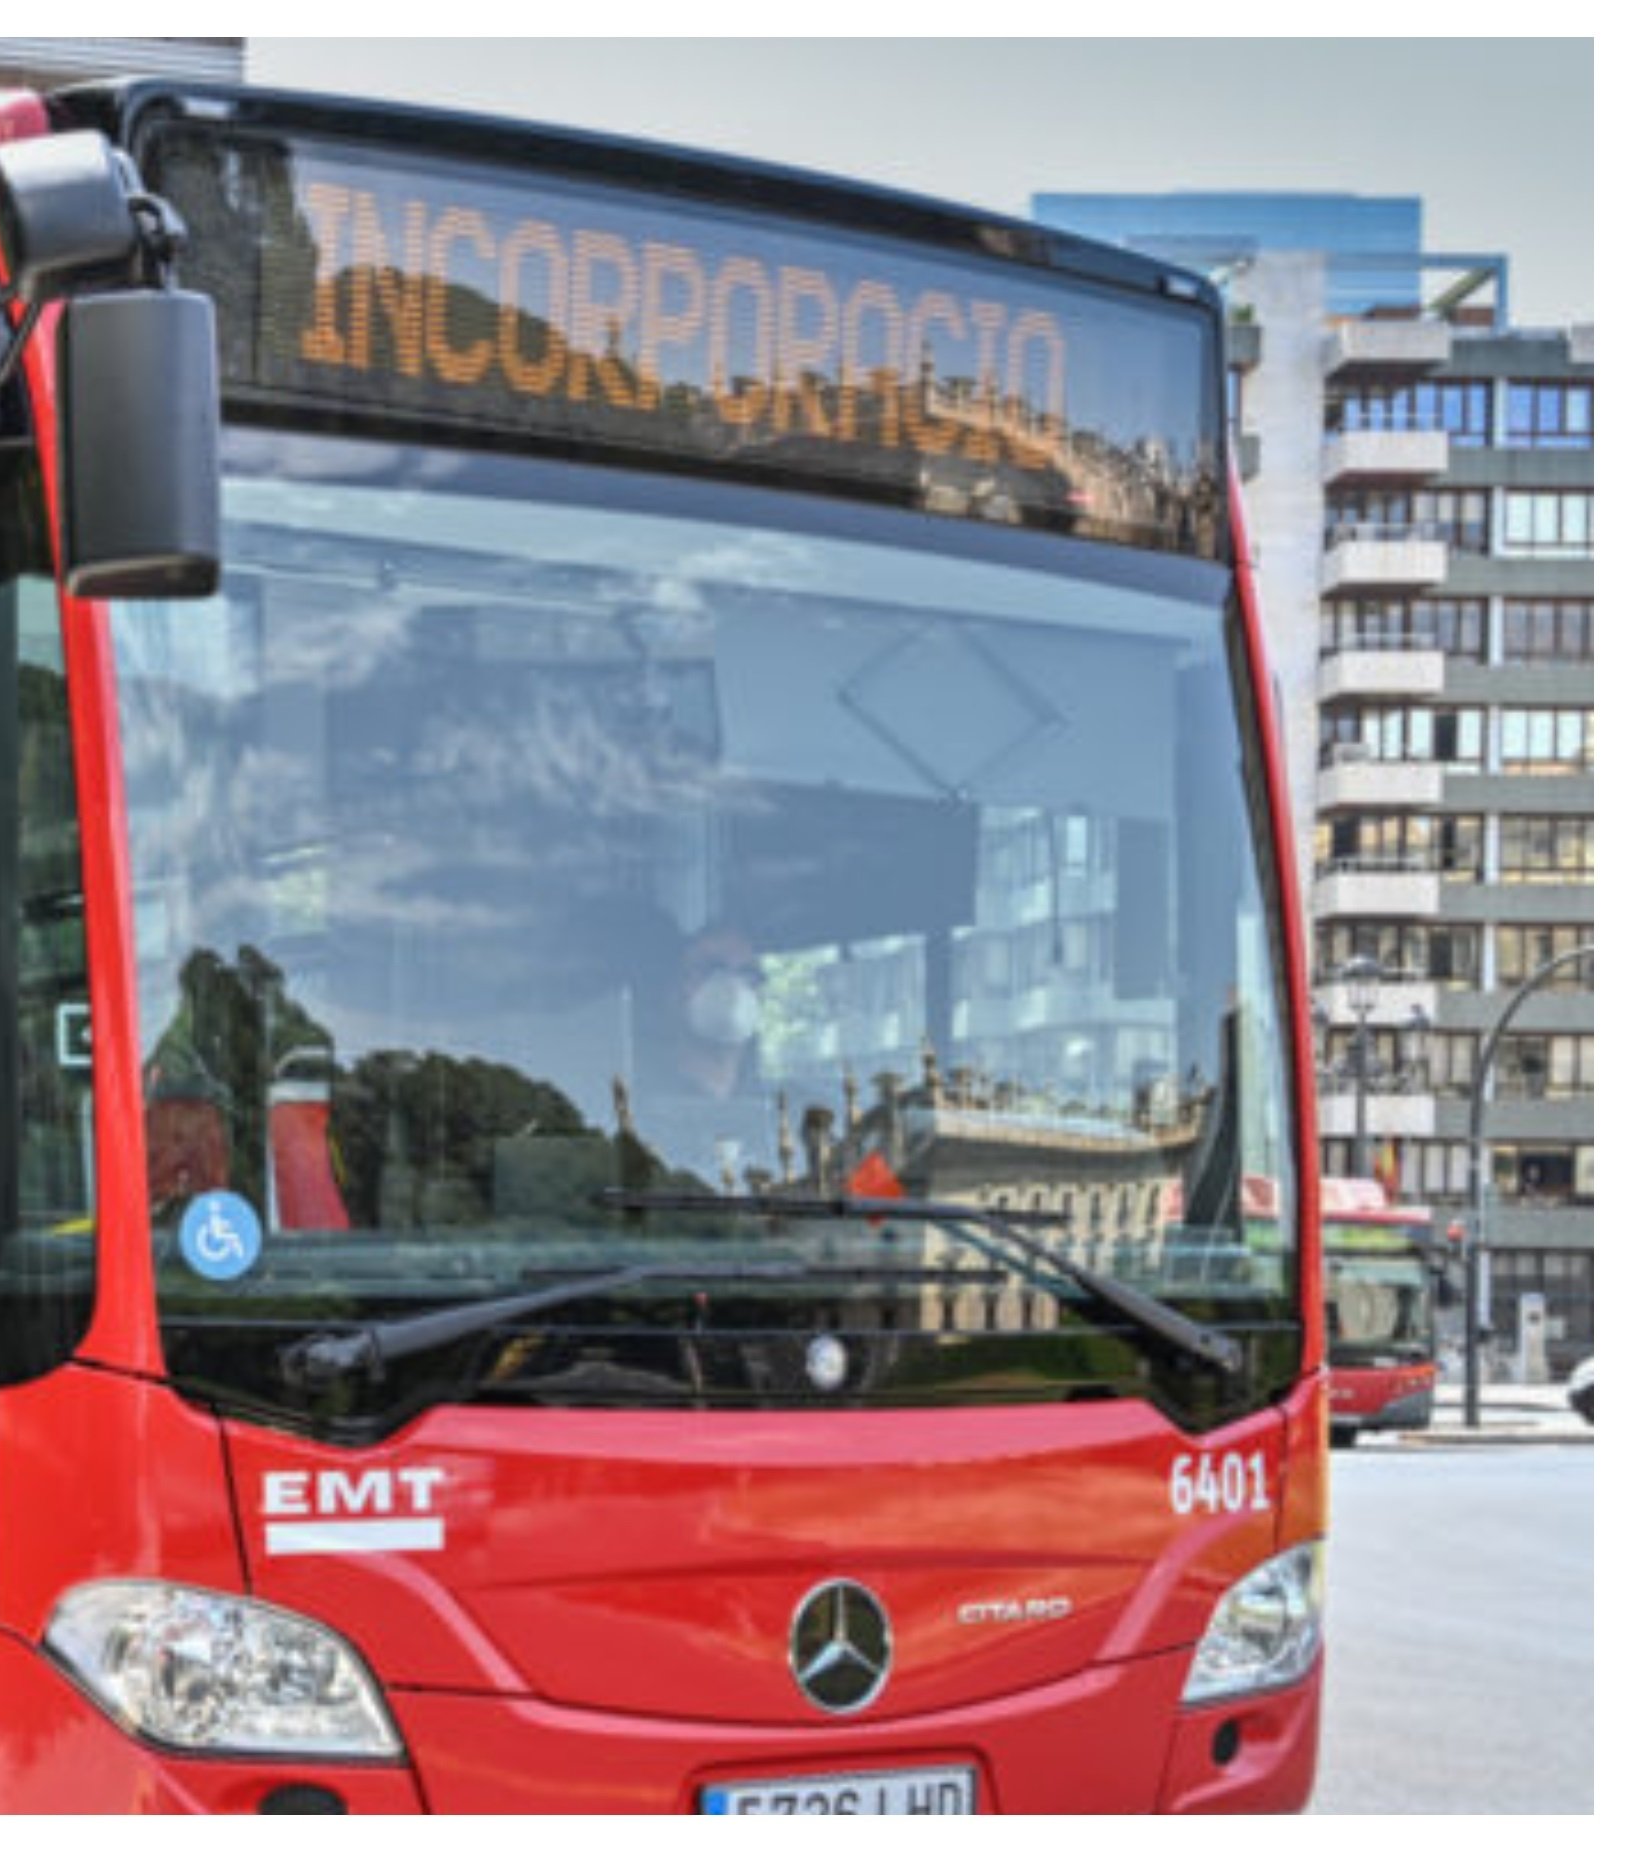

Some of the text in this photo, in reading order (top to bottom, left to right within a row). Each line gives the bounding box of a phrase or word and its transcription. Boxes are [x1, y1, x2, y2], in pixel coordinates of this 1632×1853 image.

[302, 182, 1065, 472] INCORPORACIO
[262, 1465, 446, 1515] EMT
[1171, 1450, 1270, 1515] 6401
